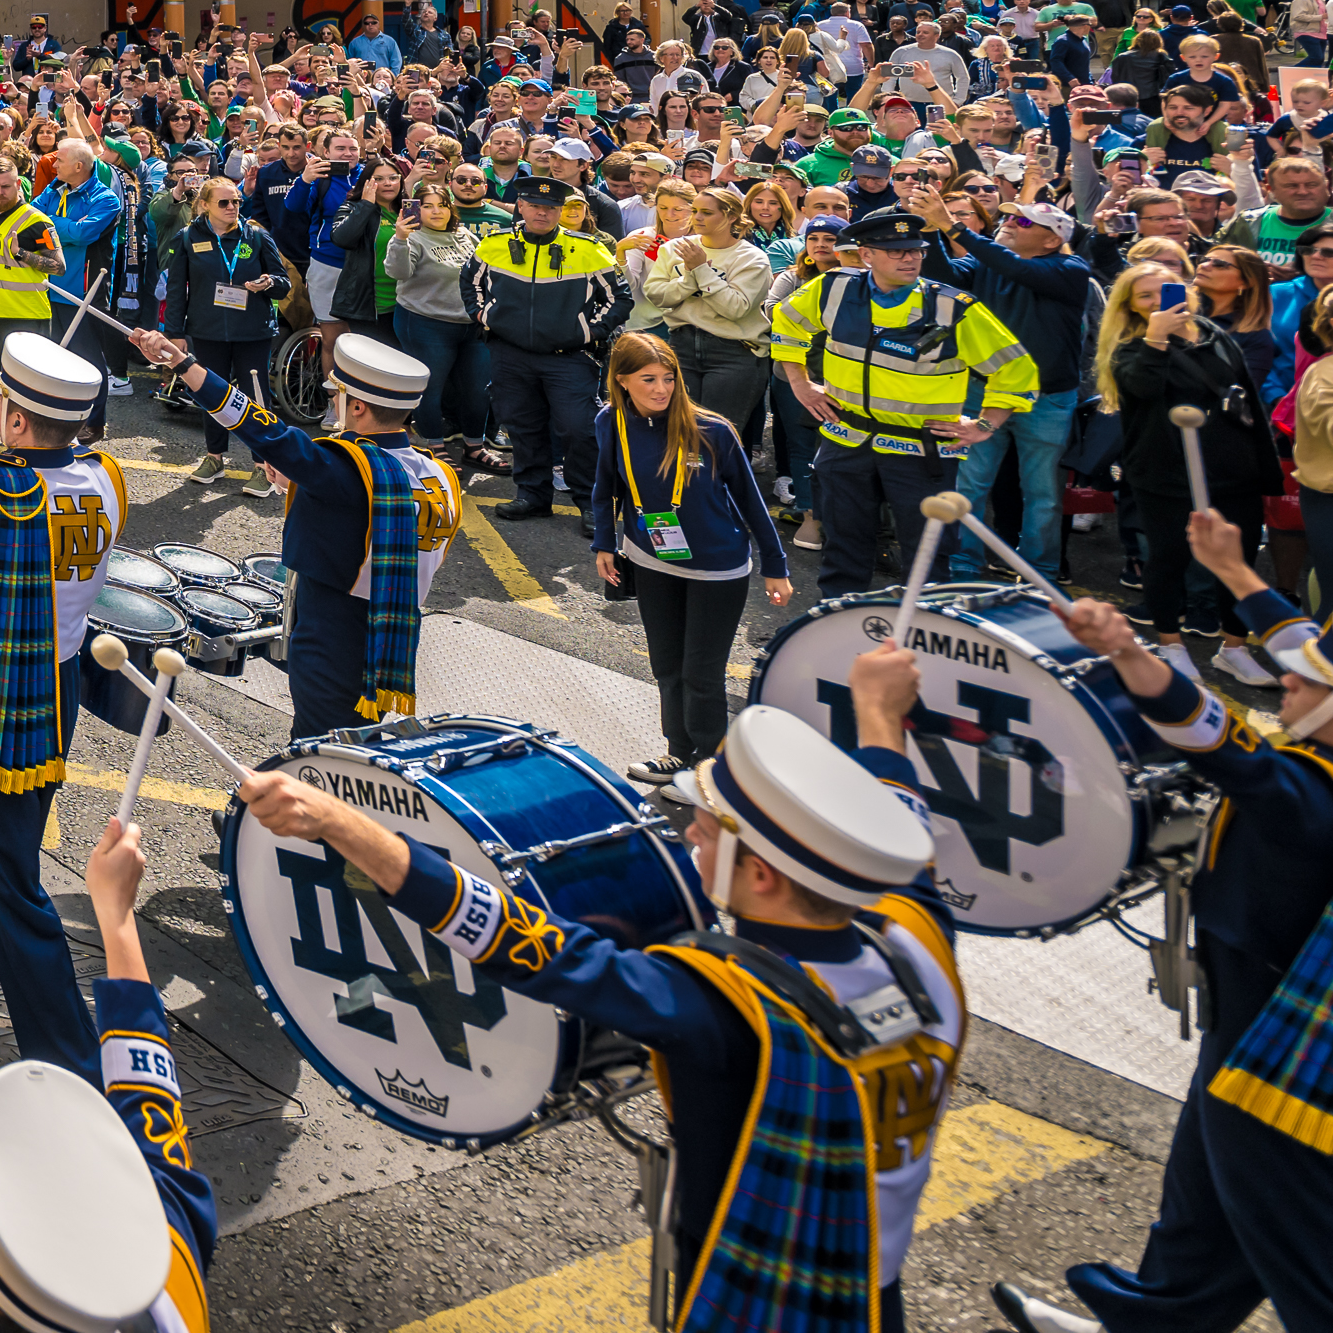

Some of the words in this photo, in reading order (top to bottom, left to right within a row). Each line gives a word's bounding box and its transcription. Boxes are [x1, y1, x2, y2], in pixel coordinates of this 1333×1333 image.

[882, 340, 913, 354] GARDA
[876, 437, 921, 454] GARDA
[902, 625, 1009, 674] YAMAHA
[326, 772, 429, 823] YAMAHA
[455, 874, 493, 946] RISH
[386, 1079, 445, 1114] REMO
